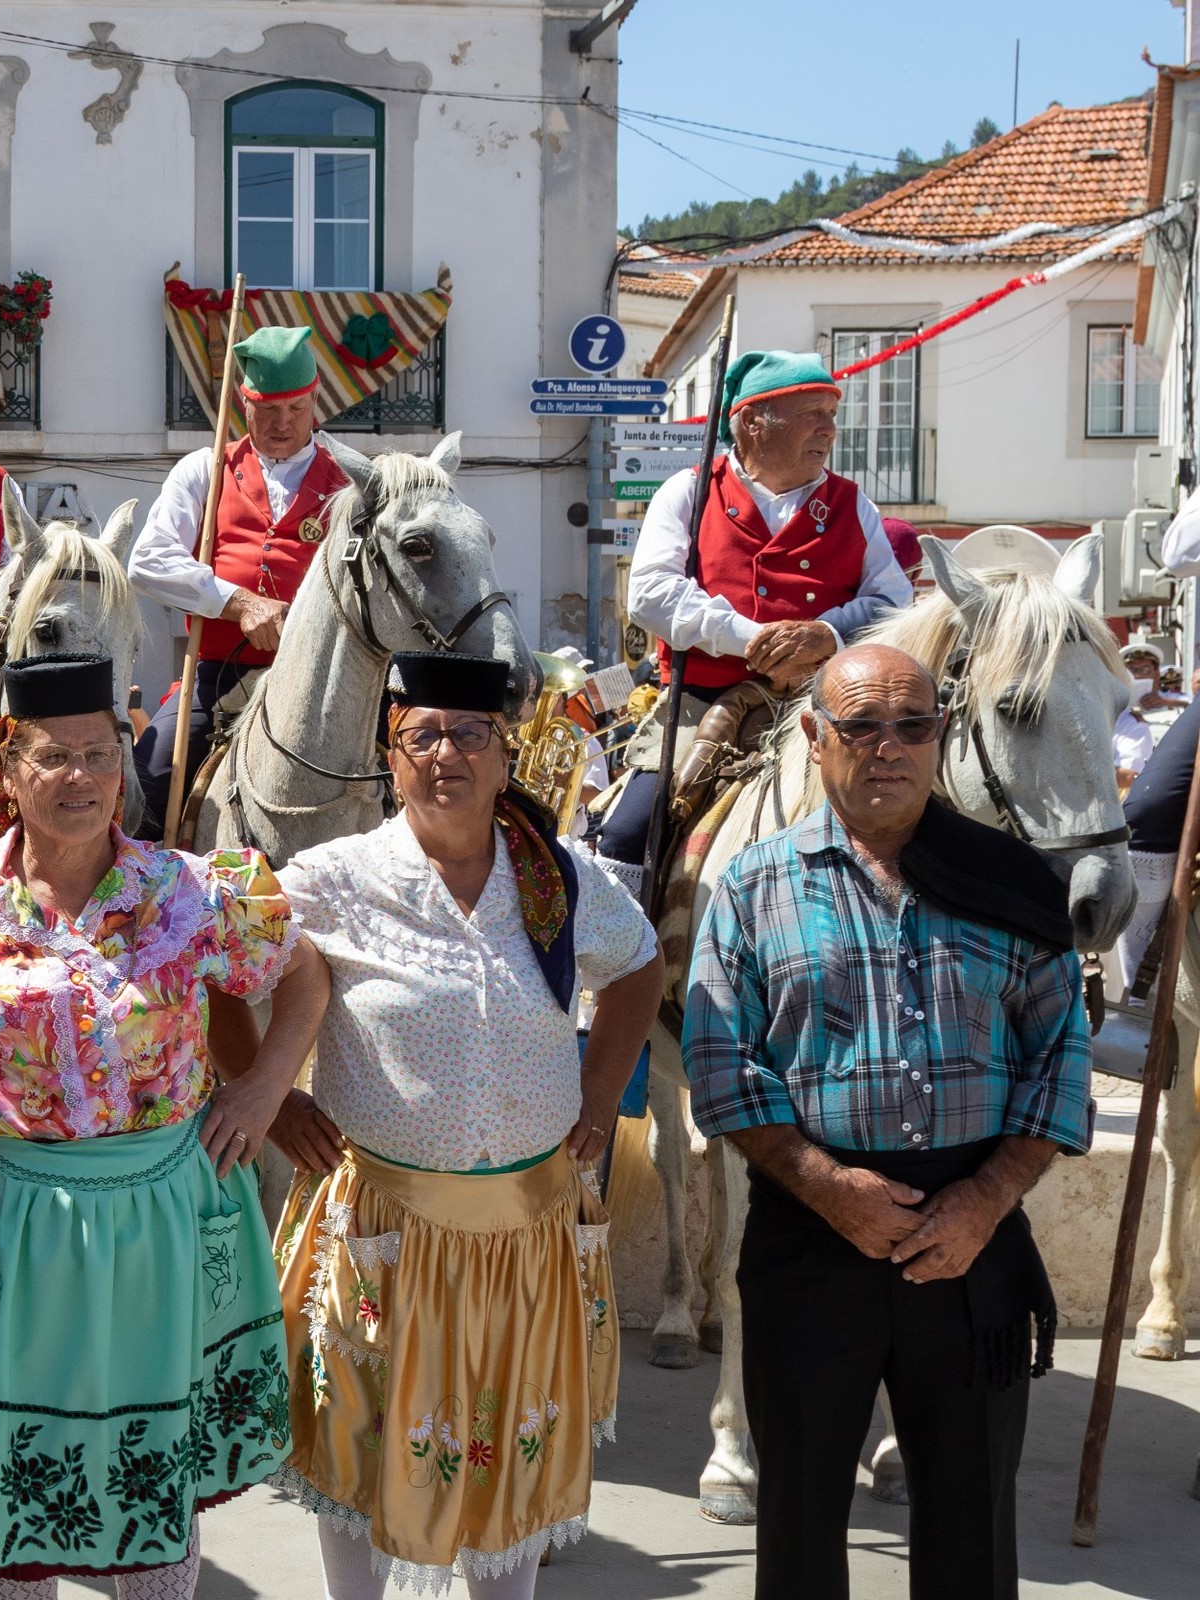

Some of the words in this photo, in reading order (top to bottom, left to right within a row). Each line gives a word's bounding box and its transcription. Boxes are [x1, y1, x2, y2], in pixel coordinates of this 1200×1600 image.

[547, 382, 565, 393] Pça.
[567, 382, 596, 393] Afonso
[598, 382, 652, 394] Albuquerque
[535, 402, 547, 411] Rua
[556, 402, 575, 414] Miguel
[575, 402, 603, 412] Bombarda
[623, 430, 647, 441] Junta
[649, 430, 660, 441] de
